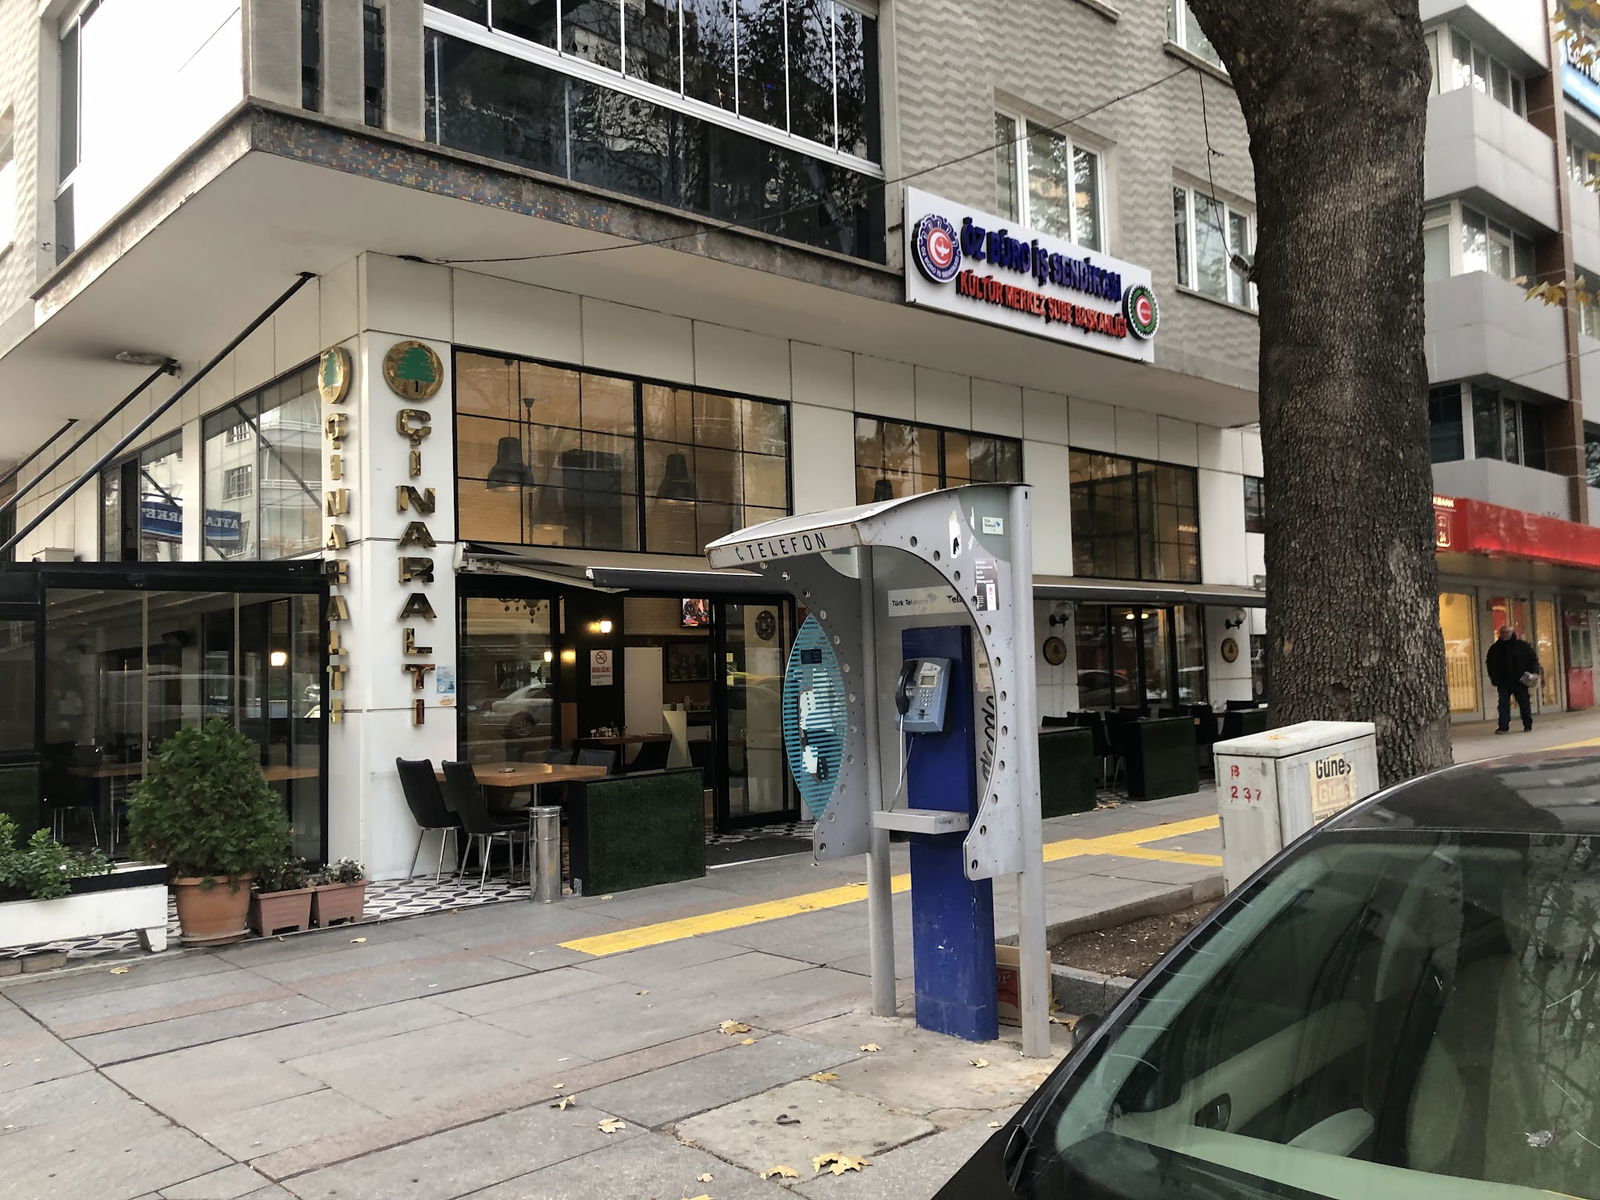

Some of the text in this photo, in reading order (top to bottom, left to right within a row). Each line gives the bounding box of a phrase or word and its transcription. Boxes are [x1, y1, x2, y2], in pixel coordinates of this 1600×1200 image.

[961, 217, 1121, 302] ÖZ BÜRO İŞ SENDİKASI
[957, 269, 1004, 304] KÜLTÜR
[1004, 284, 1046, 316] MERKEZ
[1047, 297, 1073, 323] ŞUBE
[396, 408, 436, 727] ÇINARALTI
[746, 532, 827, 560] TELEFON
[1230, 764, 1240, 778] B
